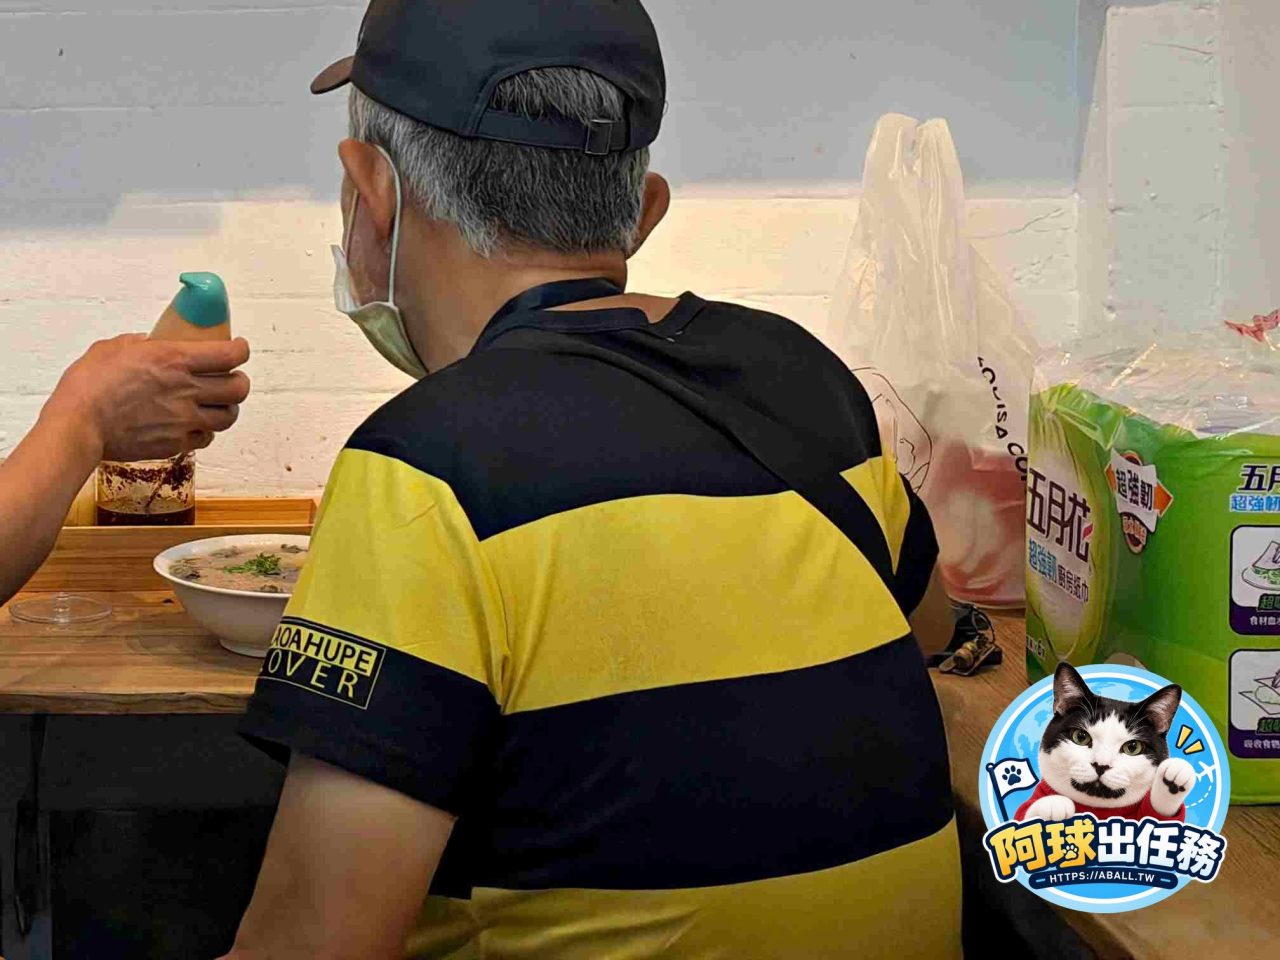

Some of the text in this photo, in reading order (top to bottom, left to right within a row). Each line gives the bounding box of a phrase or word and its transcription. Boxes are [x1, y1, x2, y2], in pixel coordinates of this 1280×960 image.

[1026, 468, 1093, 563] 五月花
[266, 648, 359, 699] OVER
